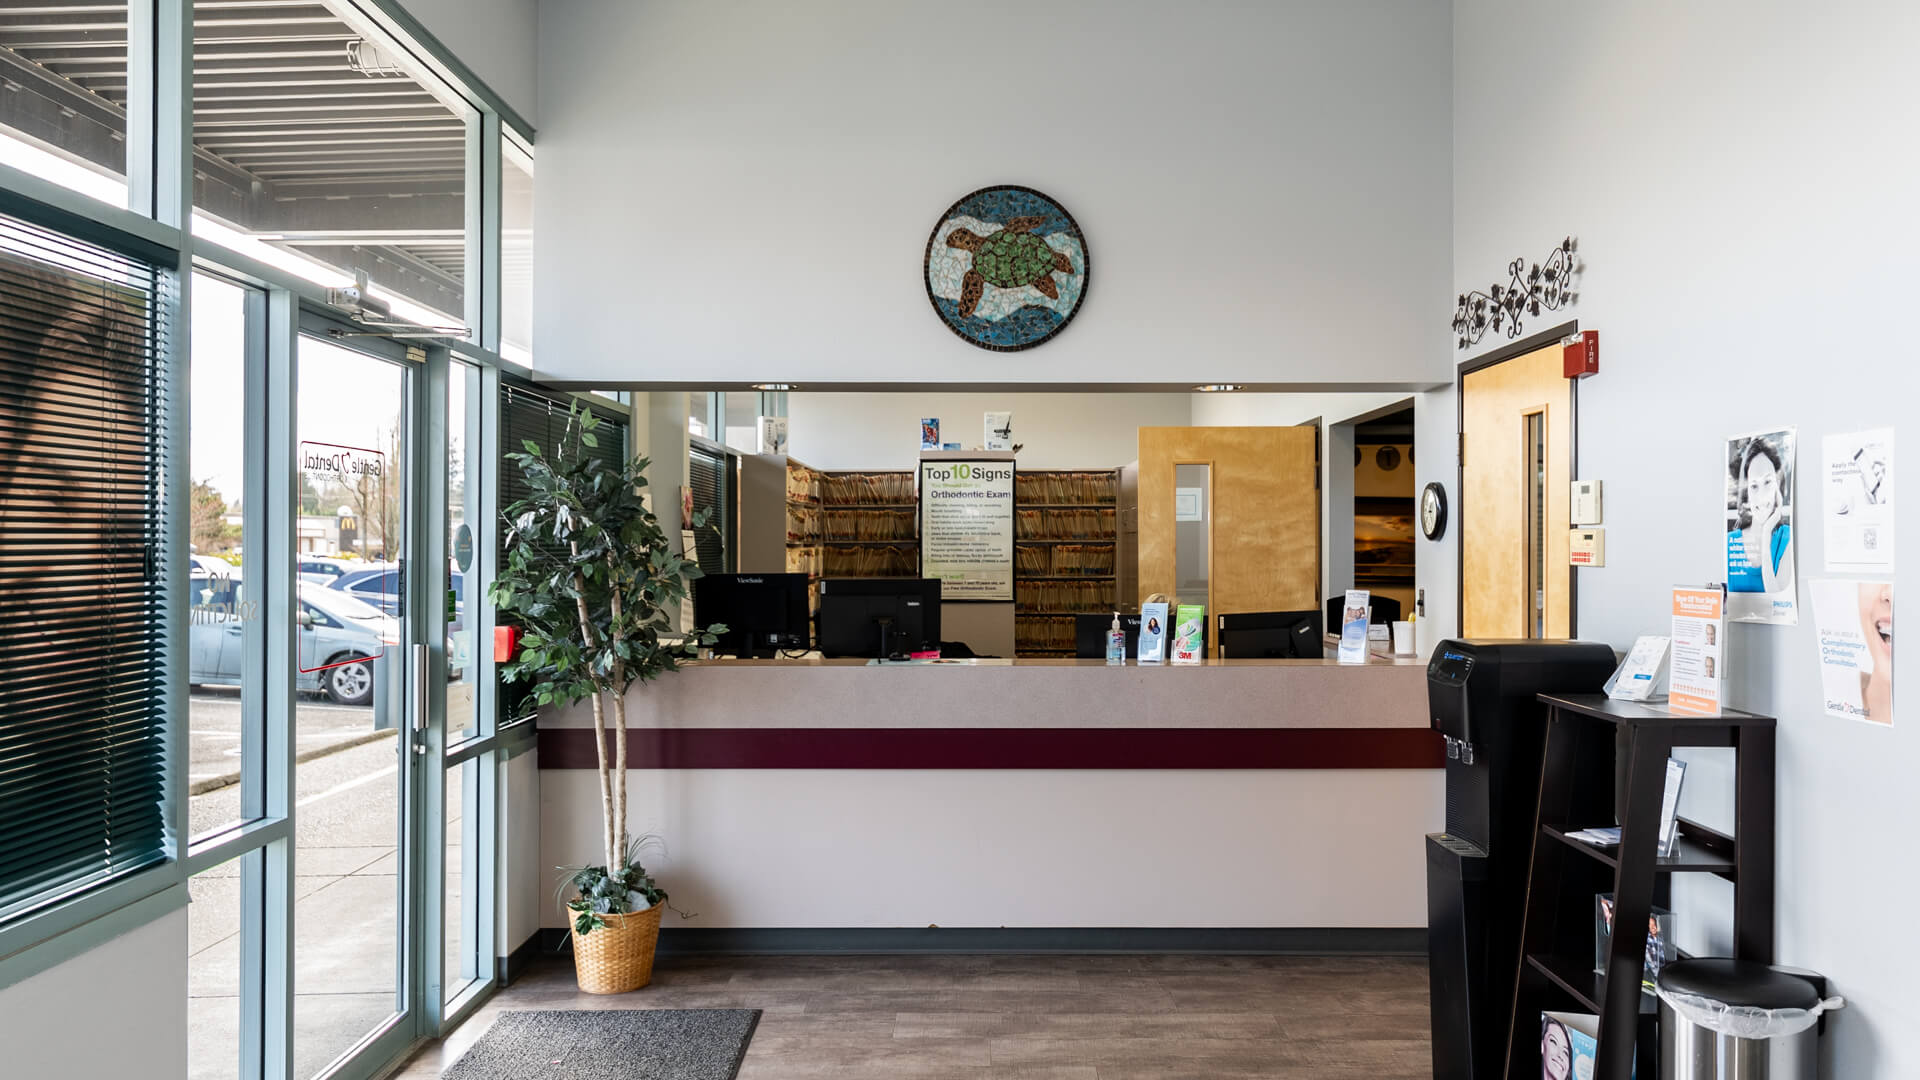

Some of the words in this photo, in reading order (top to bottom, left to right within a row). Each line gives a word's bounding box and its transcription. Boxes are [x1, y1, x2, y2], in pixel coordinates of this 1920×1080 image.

[925, 467, 951, 482] Top
[951, 464, 971, 480] 10
[972, 467, 1011, 482] Signs
[931, 490, 984, 499] Orthodontic
[986, 490, 1011, 499] Exam
[1178, 652, 1192, 660] 3M
[1826, 700, 1844, 711] Gentle
[1849, 704, 1871, 717] Dental
